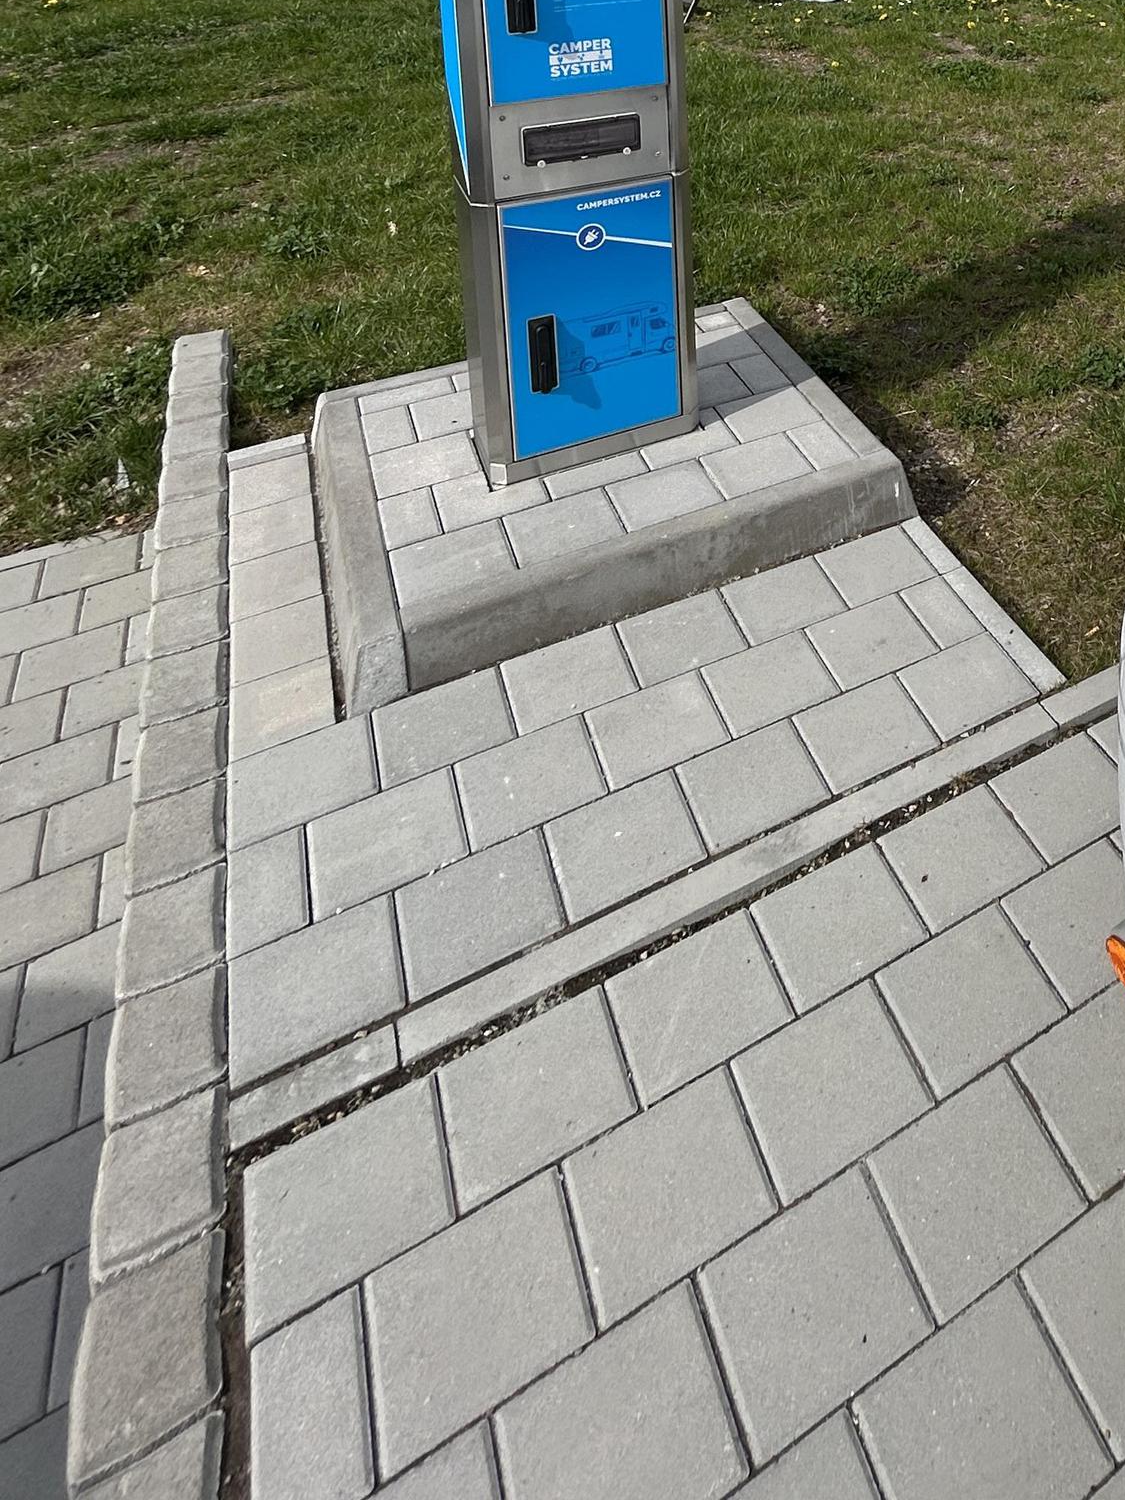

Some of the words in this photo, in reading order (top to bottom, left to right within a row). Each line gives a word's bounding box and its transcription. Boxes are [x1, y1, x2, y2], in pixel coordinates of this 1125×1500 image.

[548, 38, 611, 55] CAMPER
[550, 59, 613, 78] SYSTEM
[576, 189, 662, 211] CAMPERSYSTEM.CZ
